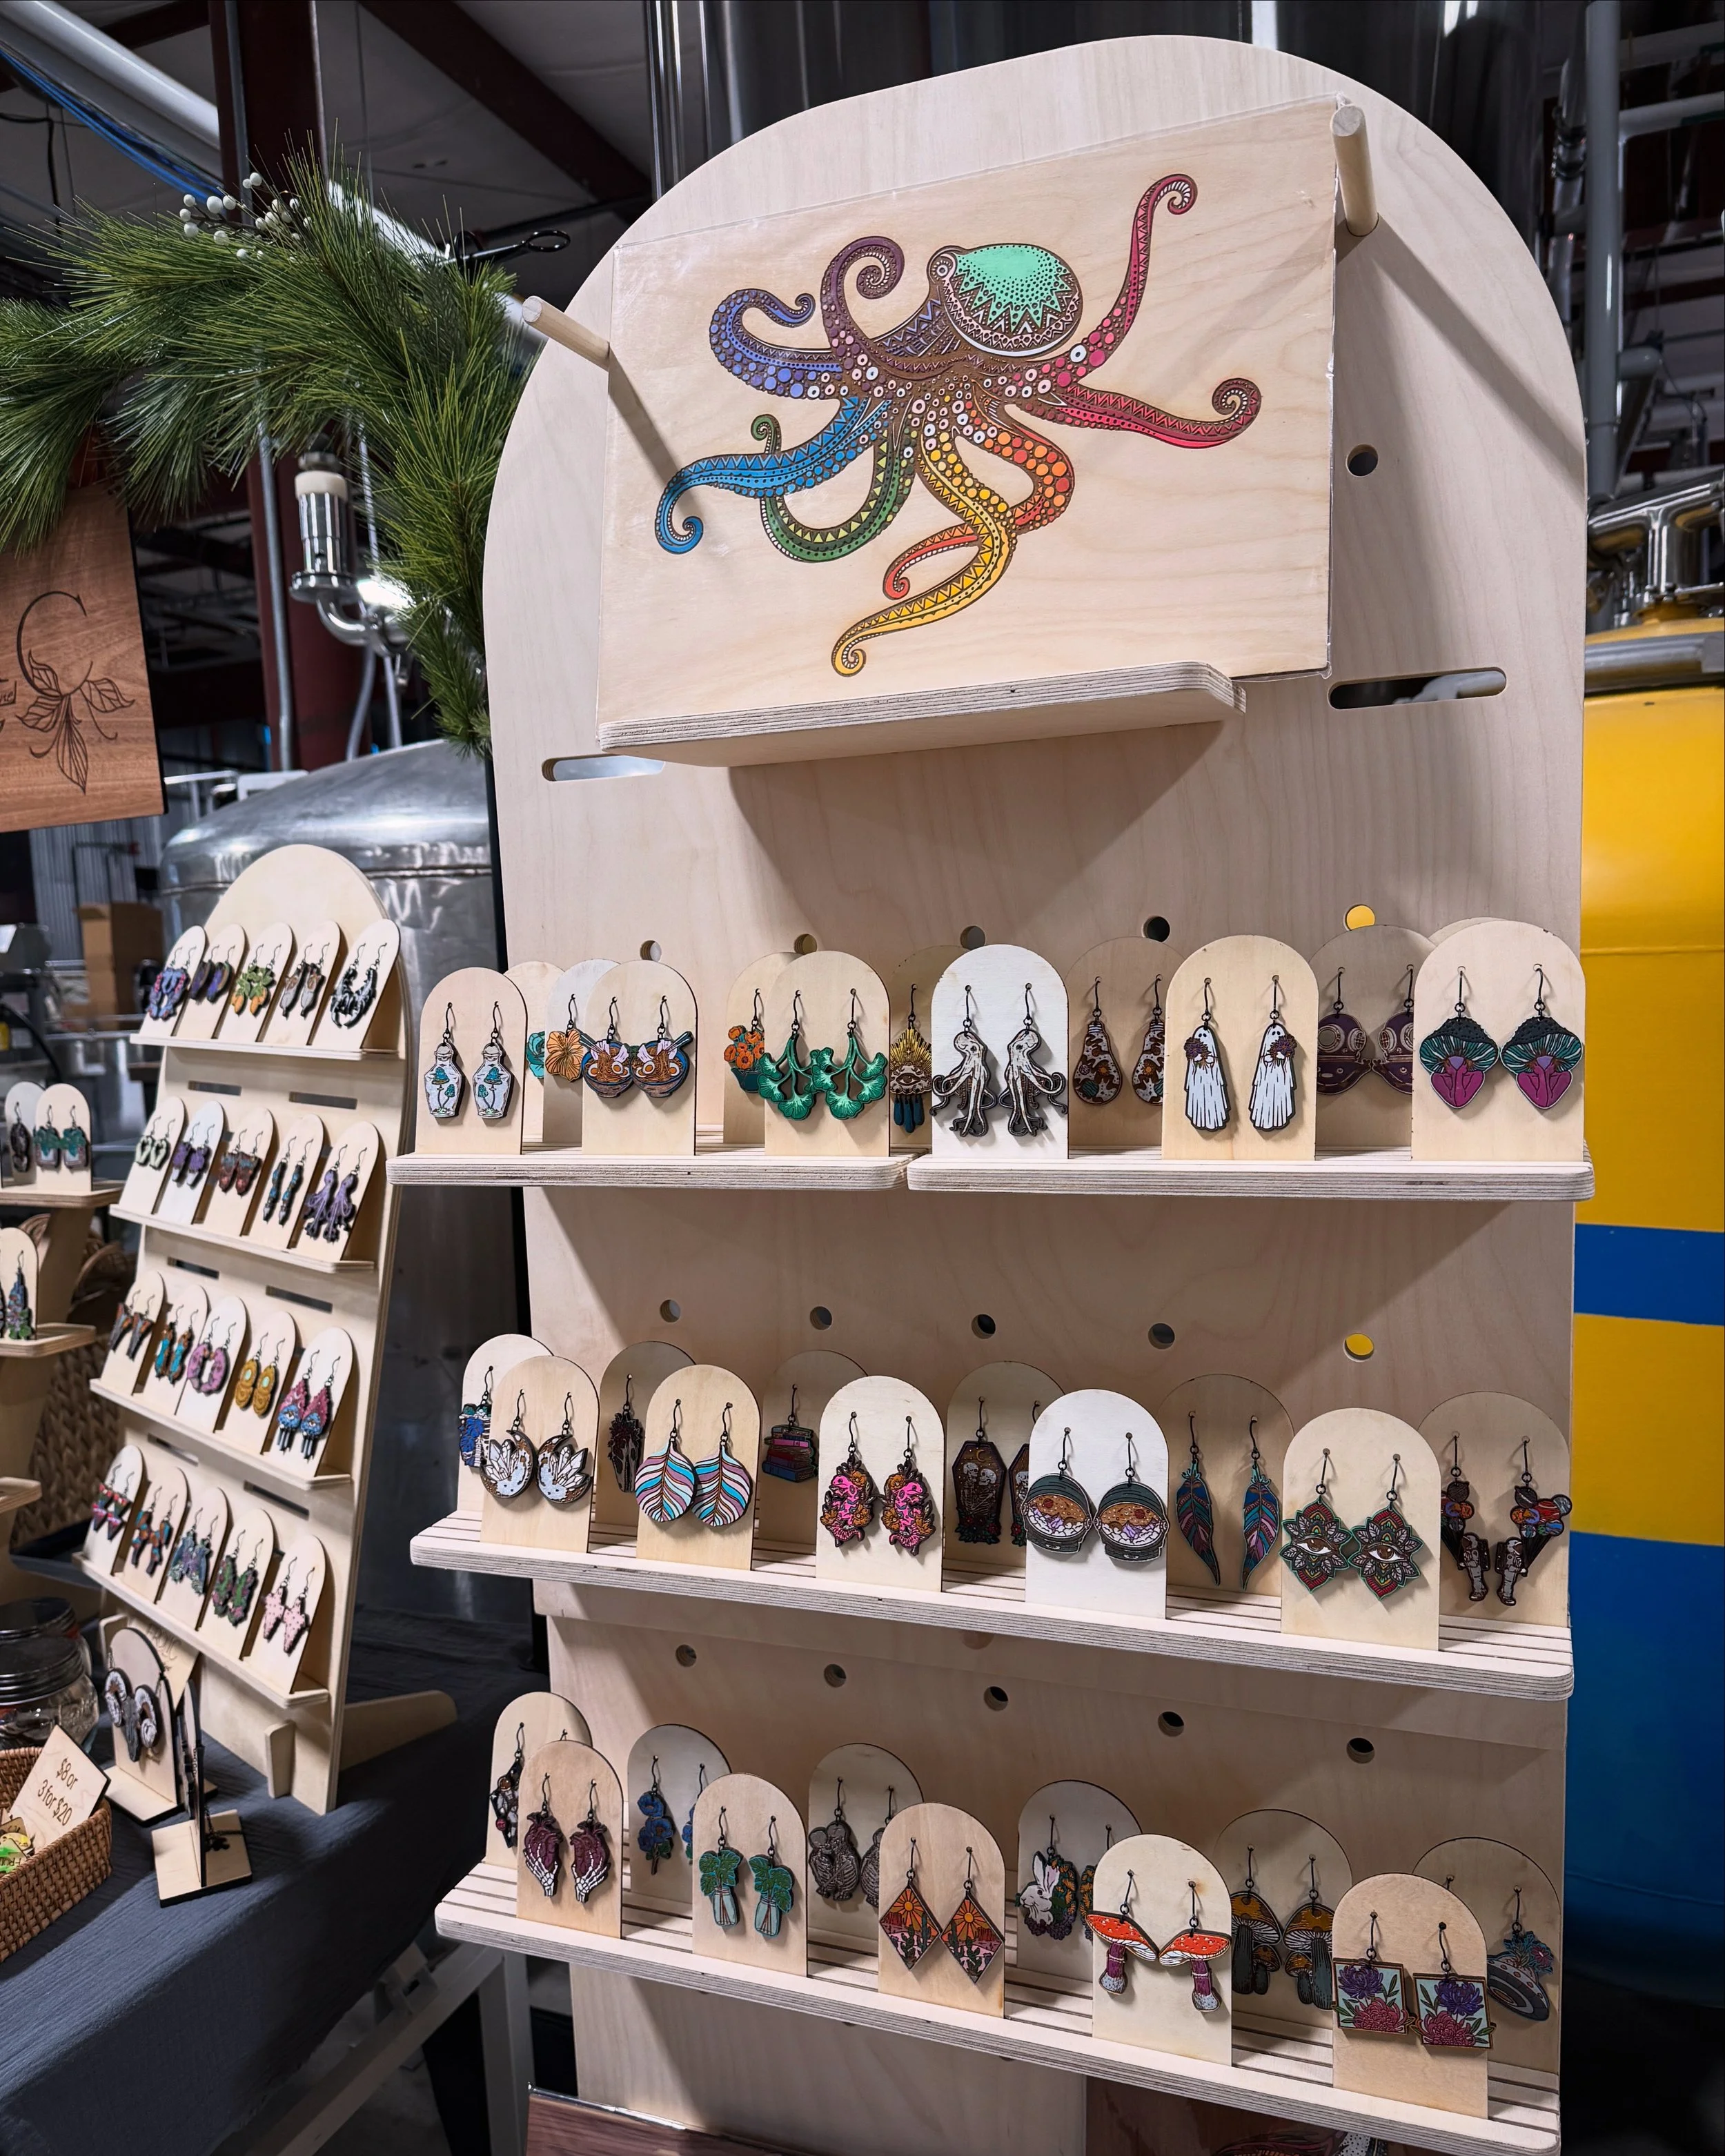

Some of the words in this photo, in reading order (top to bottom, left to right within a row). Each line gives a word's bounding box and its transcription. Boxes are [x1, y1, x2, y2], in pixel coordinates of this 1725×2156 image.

[57, 1757, 72, 1781] $8
[66, 1772, 79, 1790] or
[37, 1779, 48, 1797] 3
[43, 1785, 57, 1809] for
[53, 1796, 72, 1826] $20
